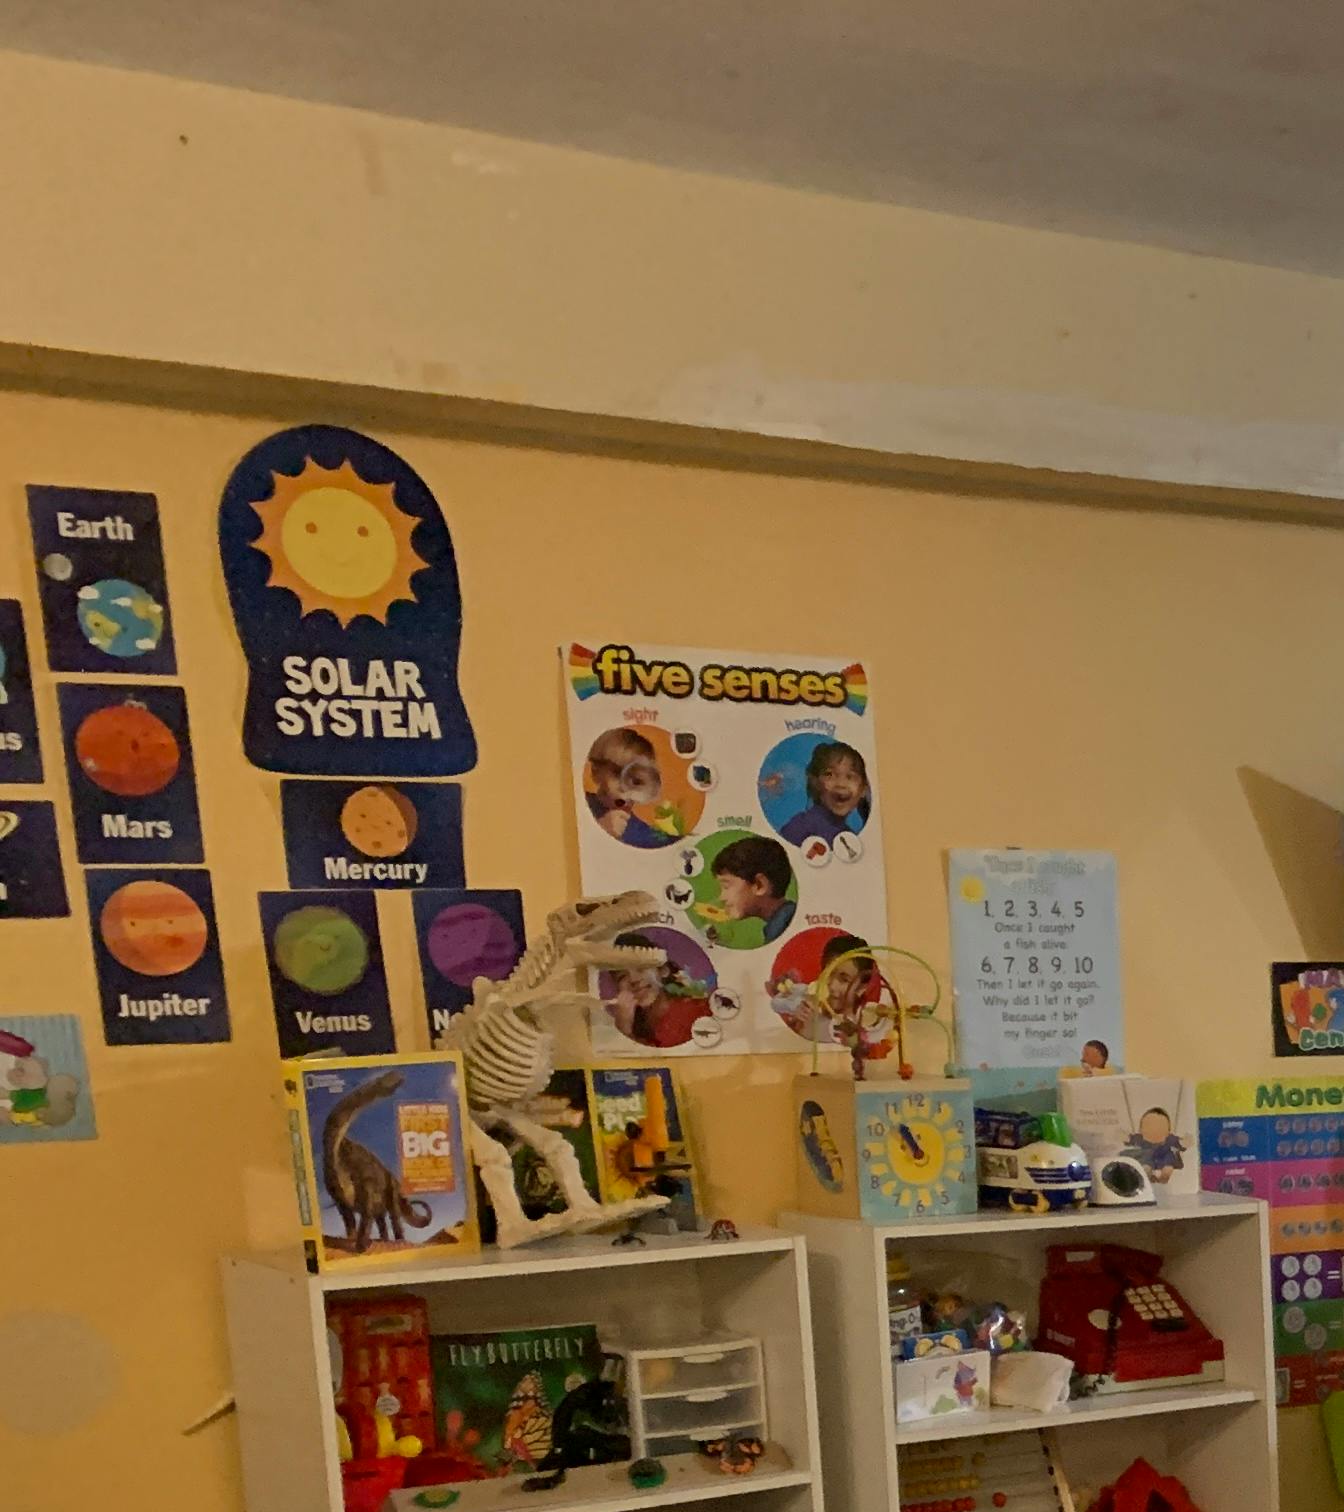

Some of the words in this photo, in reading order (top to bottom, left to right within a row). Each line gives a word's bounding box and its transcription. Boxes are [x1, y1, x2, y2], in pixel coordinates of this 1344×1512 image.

[57, 511, 134, 541] Earth
[283, 656, 425, 699] SOLAR
[702, 667, 848, 704] senses
[275, 698, 442, 740] SYSTEM
[623, 708, 659, 724] sight
[785, 718, 835, 735] hearing
[102, 814, 173, 840] Mars
[717, 815, 752, 828] smell
[324, 858, 428, 885] Mercury
[1074, 900, 1085, 917] 5
[804, 912, 842, 927] taste
[995, 922, 1023, 933] Once
[1039, 922, 1075, 935] caught
[1004, 941, 1010, 949] a
[1016, 938, 1036, 949] fish
[1074, 956, 1093, 974] 10
[976, 979, 1003, 990] Then
[1018, 979, 1032, 989] let
[1050, 981, 1062, 992] go
[118, 995, 210, 1023] Jupiter
[982, 995, 1008, 1007] Why
[1013, 995, 1030, 1006] did
[1044, 995, 1058, 1006] let
[296, 1011, 371, 1034] Venus
[1002, 1011, 1046, 1022] Because
[1063, 1011, 1078, 1022] bit
[402, 1131, 450, 1158] BIG
